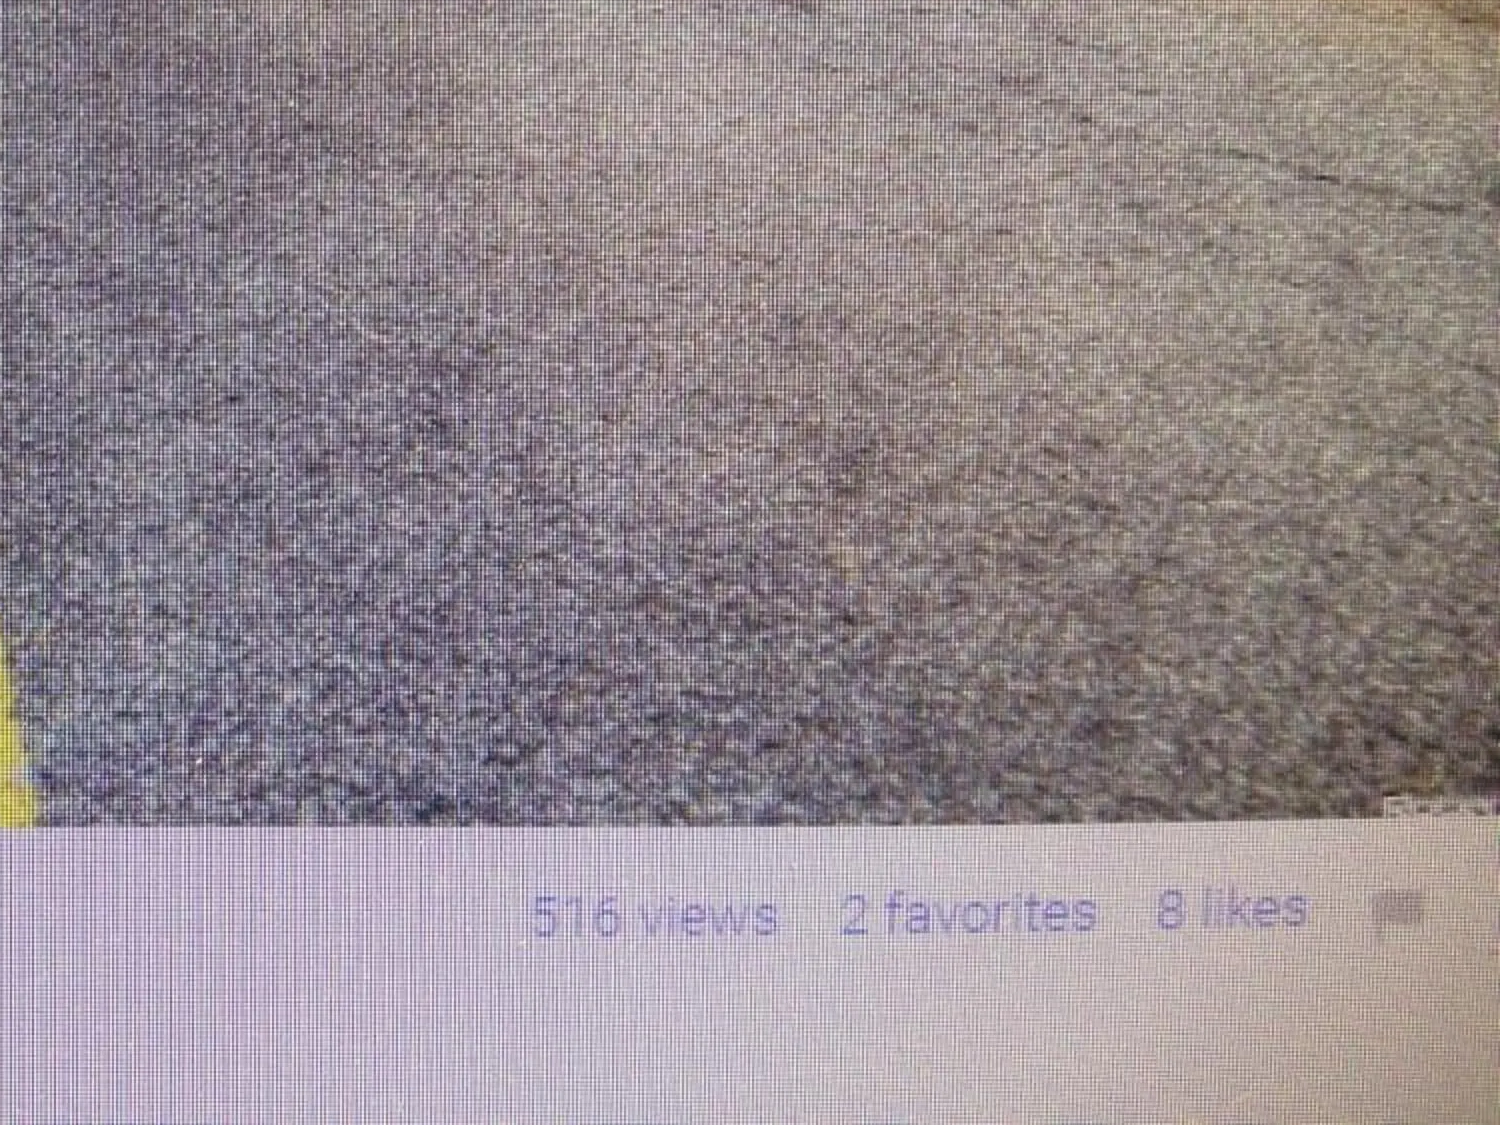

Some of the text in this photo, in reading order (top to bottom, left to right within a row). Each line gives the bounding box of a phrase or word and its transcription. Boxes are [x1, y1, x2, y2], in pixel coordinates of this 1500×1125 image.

[534, 883, 1311, 938] 516 views 2 favorites 8 likes
